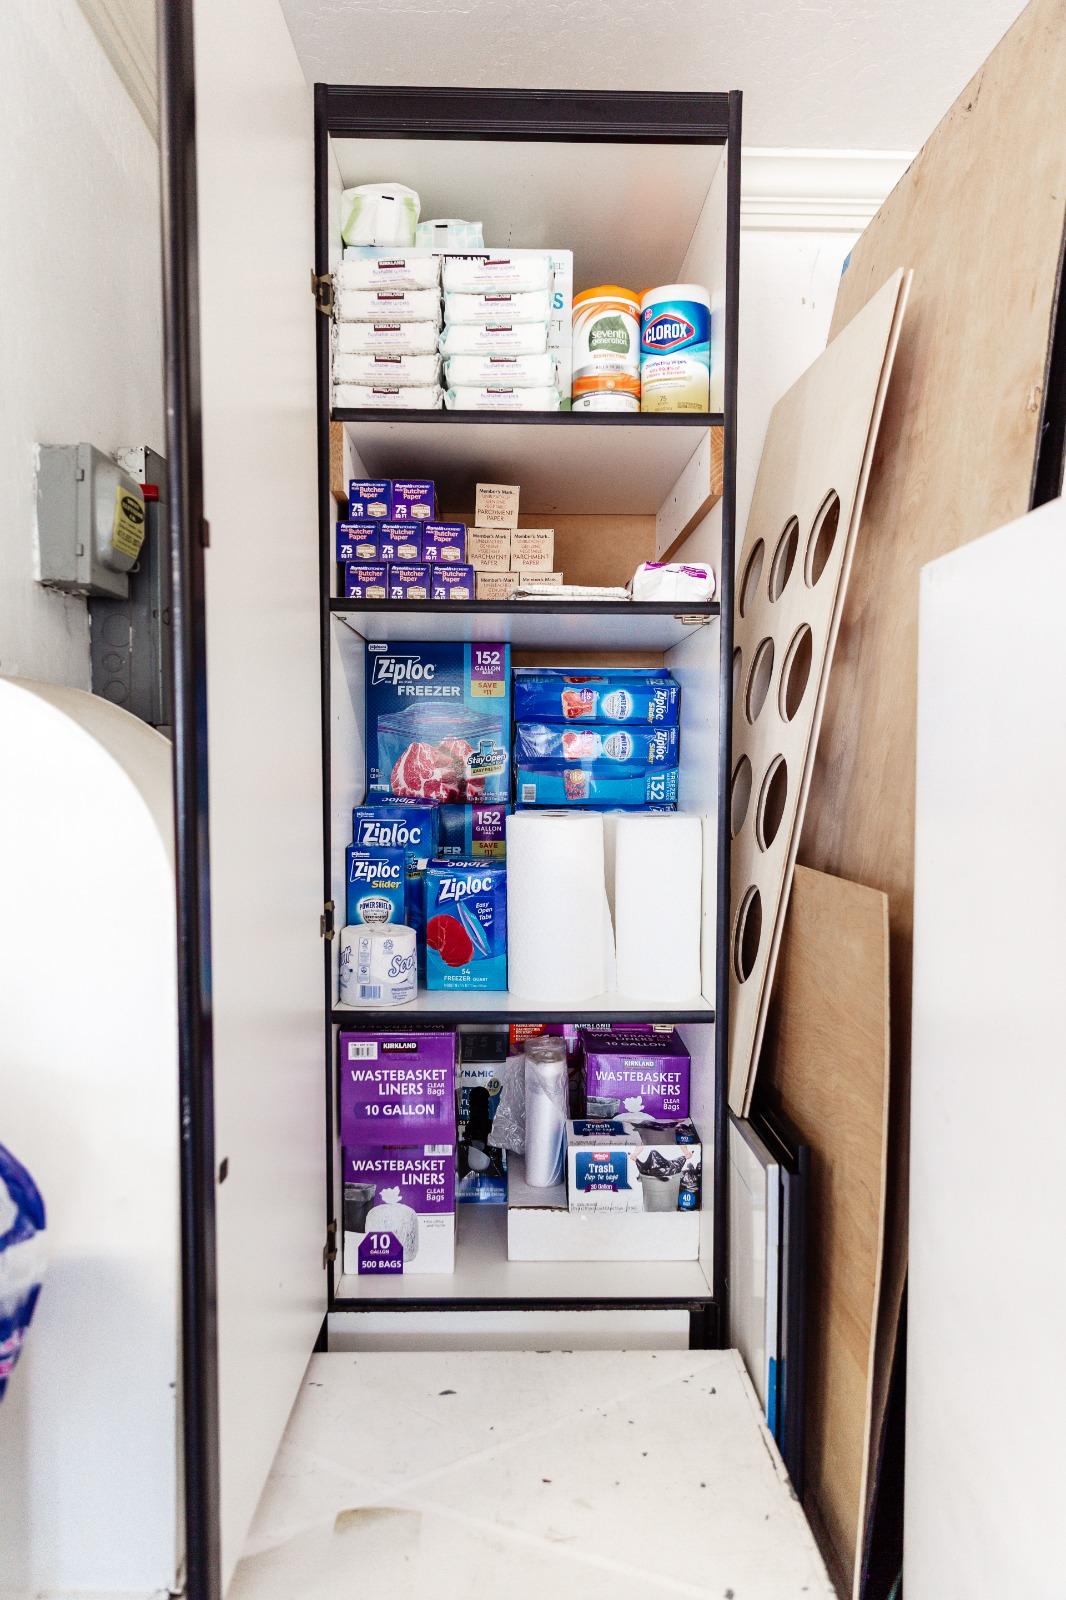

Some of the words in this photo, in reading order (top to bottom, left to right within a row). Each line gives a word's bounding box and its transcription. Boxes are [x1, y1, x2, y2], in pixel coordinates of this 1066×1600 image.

[591, 329, 627, 339] seventh
[645, 324, 688, 343] CLOROX
[591, 337, 627, 346] generation
[351, 503, 363, 512] 75
[395, 505, 407, 513] 75
[340, 545, 353, 553] 75
[382, 545, 394, 553] 75
[425, 546, 437, 555] 75
[350, 587, 362, 595] 75
[391, 587, 403, 595] 75
[434, 587, 446, 596] 75
[475, 651, 500, 665] 152
[377, 658, 435, 685] Ziploc
[397, 685, 461, 697] FREEZER
[653, 690, 667, 720] Ziploc
[653, 731, 667, 760] Ziploc
[648, 743, 656, 764] Slider
[467, 756, 485, 765] Stay
[485, 753, 507, 763] Open
[651, 774, 665, 800] 132
[476, 811, 501, 825] 152
[362, 823, 421, 845] Ziploc
[354, 861, 400, 883] Ziploc
[371, 880, 402, 889] Slider
[439, 877, 493, 903] Ziploc
[360, 902, 376, 910] POWER
[376, 902, 391, 910] SHIELD
[475, 902, 490, 910] Easy
[477, 907, 493, 915] Open
[388, 946, 416, 978] Sco
[351, 1069, 448, 1081] WASTEBASKET
[461, 1070, 494, 1078] YNAMIC
[595, 1071, 682, 1083] WASTEBASKET
[378, 1083, 424, 1095] LINERS
[487, 1081, 500, 1089] 40
[640, 1084, 681, 1095] LINERS
[427, 1088, 445, 1096] Bags
[364, 1104, 379, 1116] 10
[382, 1104, 435, 1116] GALLON
[663, 1103, 680, 1111] Bags
[352, 1159, 446, 1171] WASTEBASKET
[588, 1163, 614, 1173] Trash
[401, 1173, 445, 1185] LINERS
[426, 1193, 445, 1202] Bags
[682, 1194, 691, 1202] 40
[369, 1234, 391, 1249] 10
[361, 1260, 377, 1268] 500
[378, 1260, 402, 1268] BAGS
